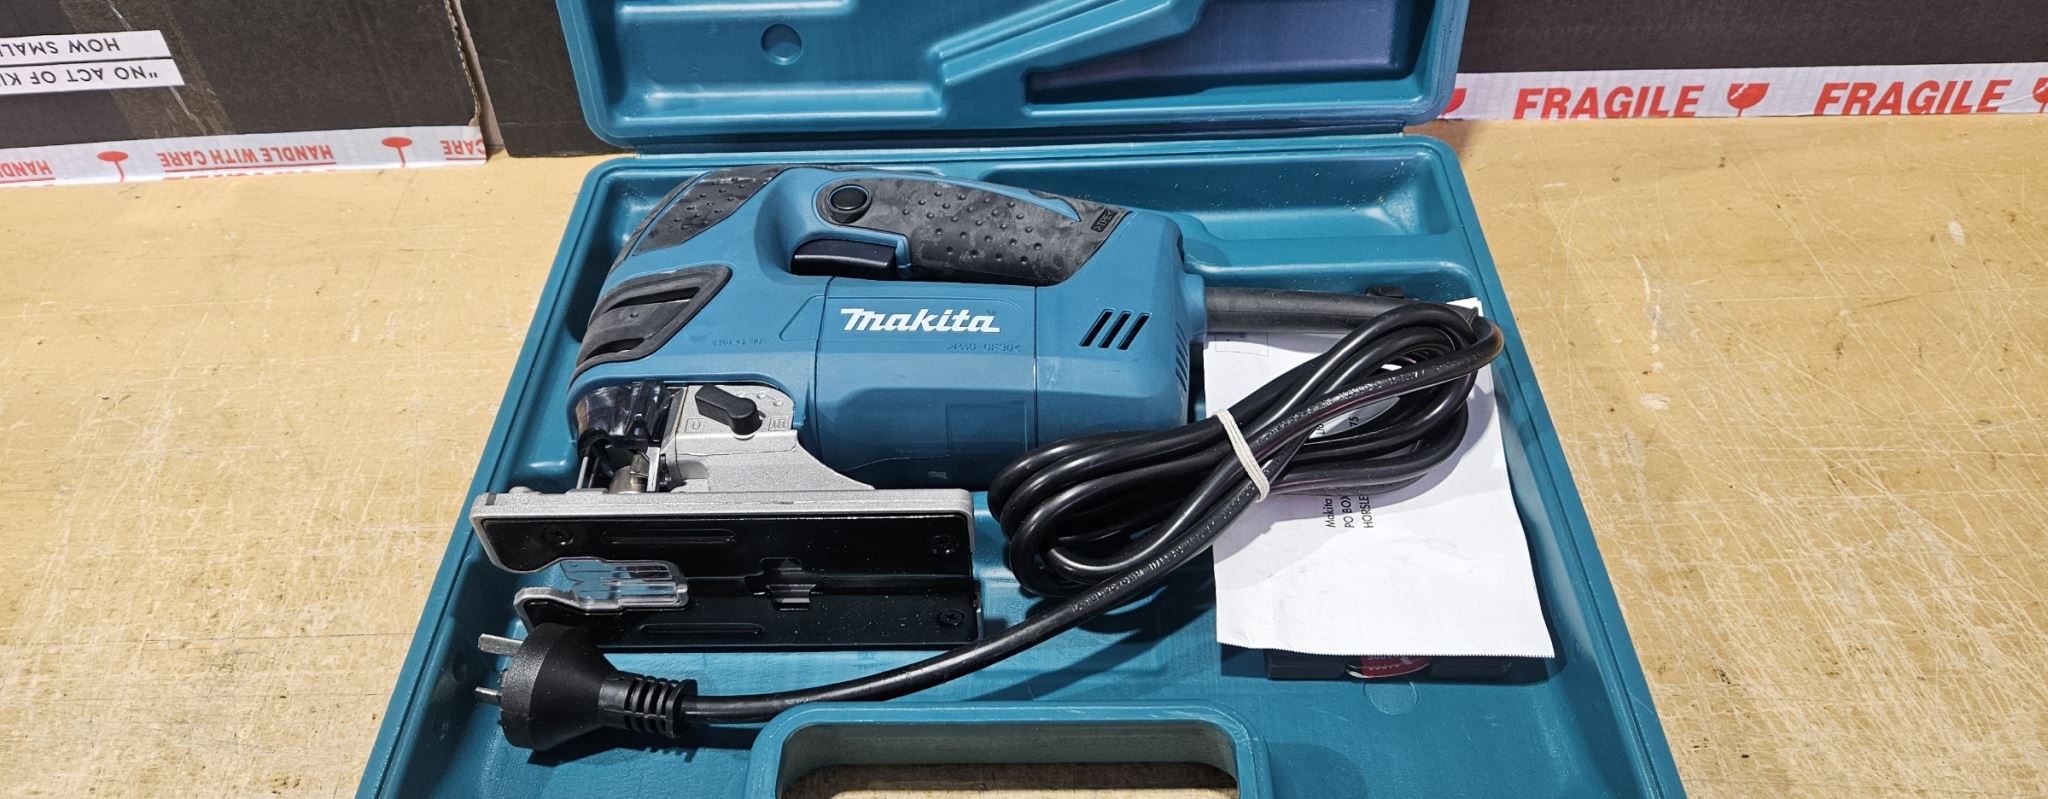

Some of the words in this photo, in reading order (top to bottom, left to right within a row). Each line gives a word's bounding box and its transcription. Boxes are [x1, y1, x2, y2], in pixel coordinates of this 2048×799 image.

[69, 37, 120, 54] HOW
[0, 73, 22, 86] KI
[31, 71, 56, 85] OF
[66, 68, 103, 82] ACT
[1512, 84, 1705, 120] FRAGILE
[1812, 79, 2013, 116] FRAGILE
[156, 151, 207, 168] CARE
[209, 148, 259, 165] WITH
[259, 144, 335, 162] HANDLE
[0, 160, 53, 177] HAND
[1323, 498, 1336, 528] Makita
[1340, 495, 1353, 514] BOX
[1359, 495, 1374, 529] HORSLE
[1343, 515, 1354, 528] PO
